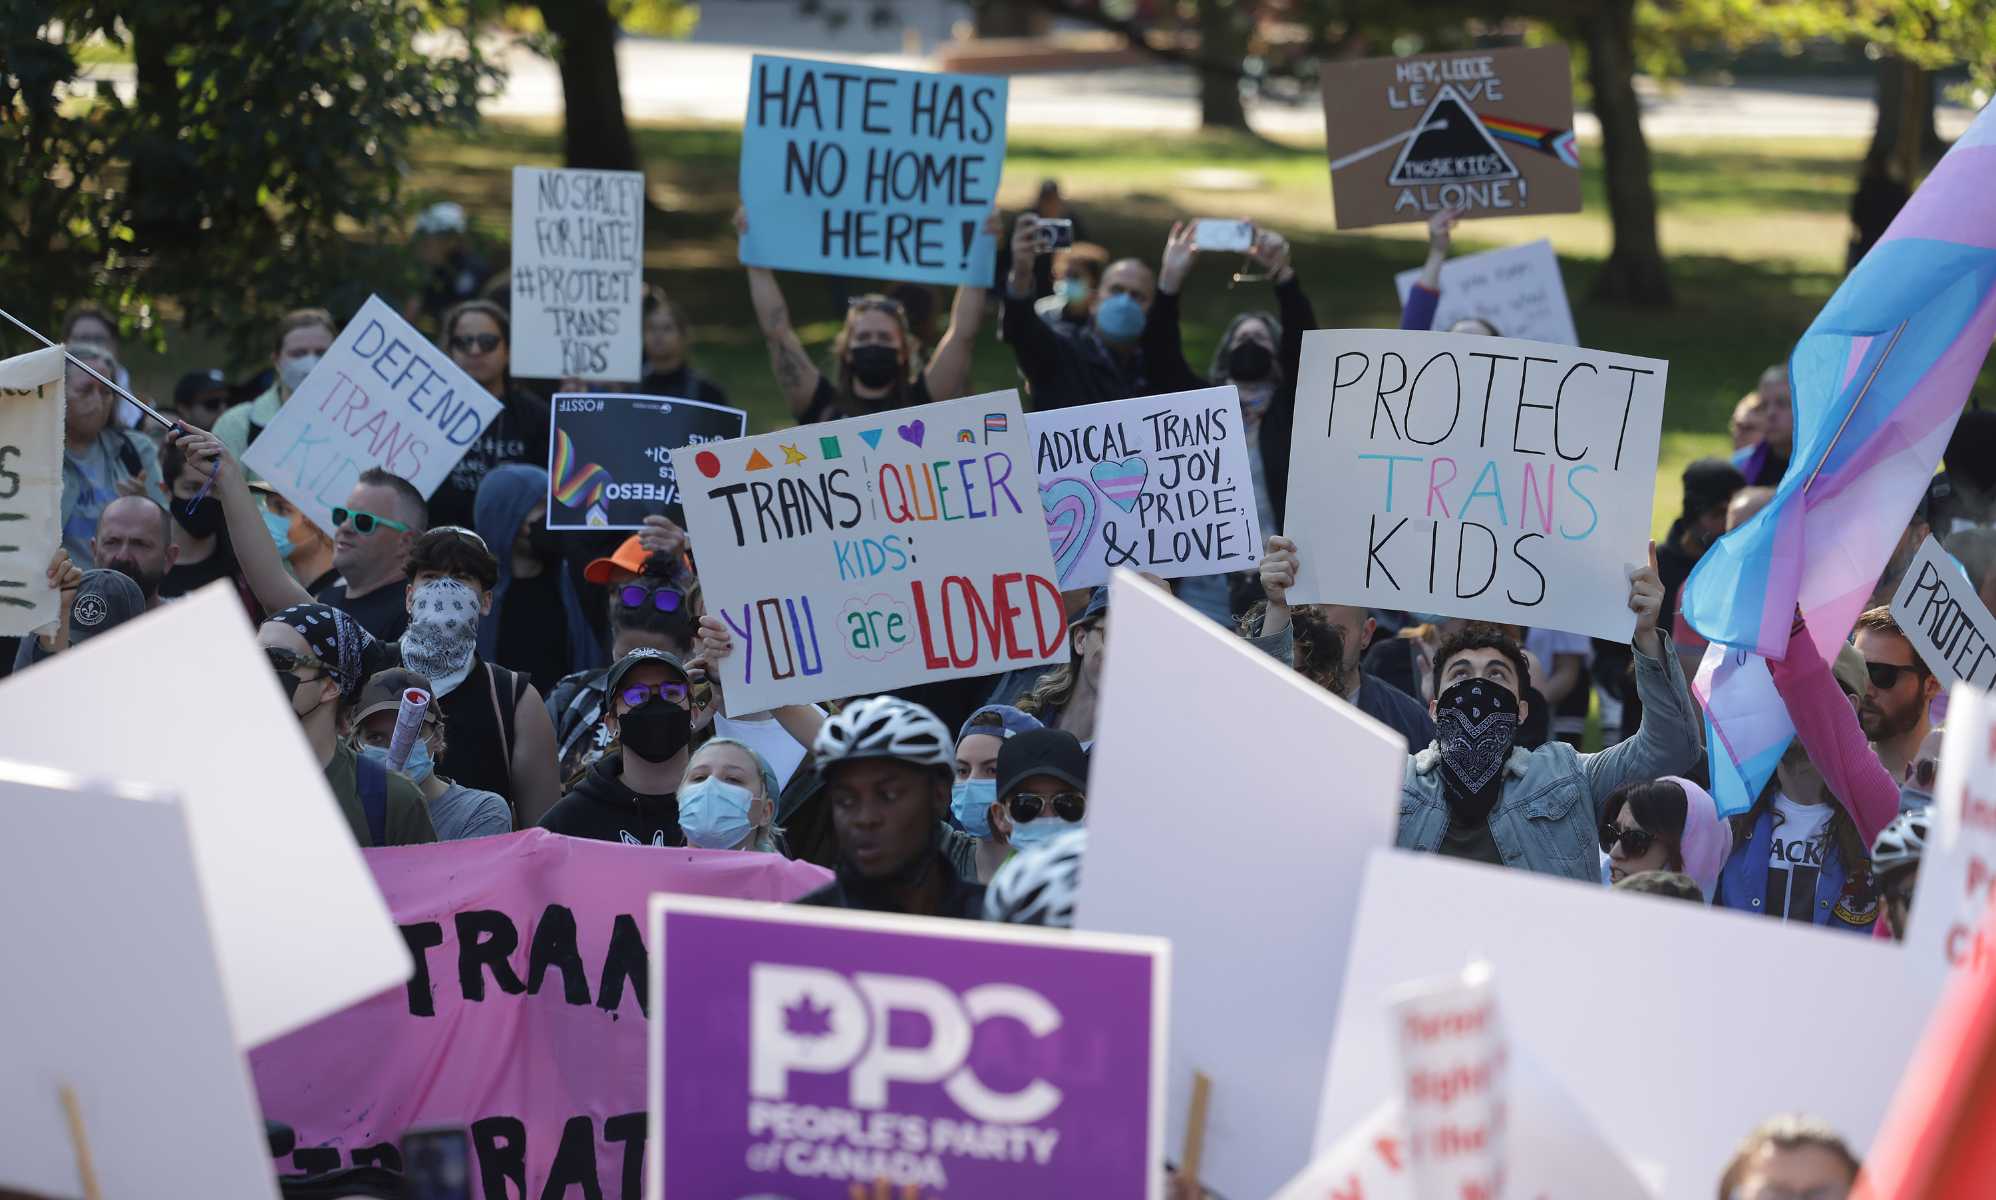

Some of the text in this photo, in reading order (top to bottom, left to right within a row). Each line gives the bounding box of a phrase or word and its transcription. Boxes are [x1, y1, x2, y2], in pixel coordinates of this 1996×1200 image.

[757, 63, 996, 144] HATE HAS
[538, 172, 569, 212] NO
[784, 139, 988, 206] NO HOME
[1453, 153, 1503, 176] KIDS
[535, 217, 577, 259] FOR
[514, 263, 635, 304] #PROTECT
[543, 306, 621, 337] TRANS
[351, 319, 482, 447] DEFEND
[560, 339, 610, 376] KIDS
[319, 370, 429, 481] TRANS
[559, 399, 604, 412] #OSSTF
[1327, 351, 1655, 471] PROTECT
[274, 424, 362, 511] KID
[1037, 408, 1229, 475] ADICAL TRANS
[1158, 446, 1232, 490] JOY,
[708, 467, 862, 547] TRANS
[878, 452, 1024, 524] QUEER
[1358, 453, 1599, 541] TRANS
[833, 533, 917, 581] KIDS:
[1102, 519, 1256, 567] & LOVE!
[1366, 514, 1546, 607] KIDS
[721, 572, 1068, 684] YOU are LOVED
[1904, 560, 1996, 692] PROTEC
[1769, 838, 1823, 865] ACK
[399, 903, 649, 1019] TRAN
[748, 961, 1064, 1126] PPC
[745, 1140, 949, 1191] of CANADA
[748, 1100, 1060, 1165] PEOPLE'S PARTY
